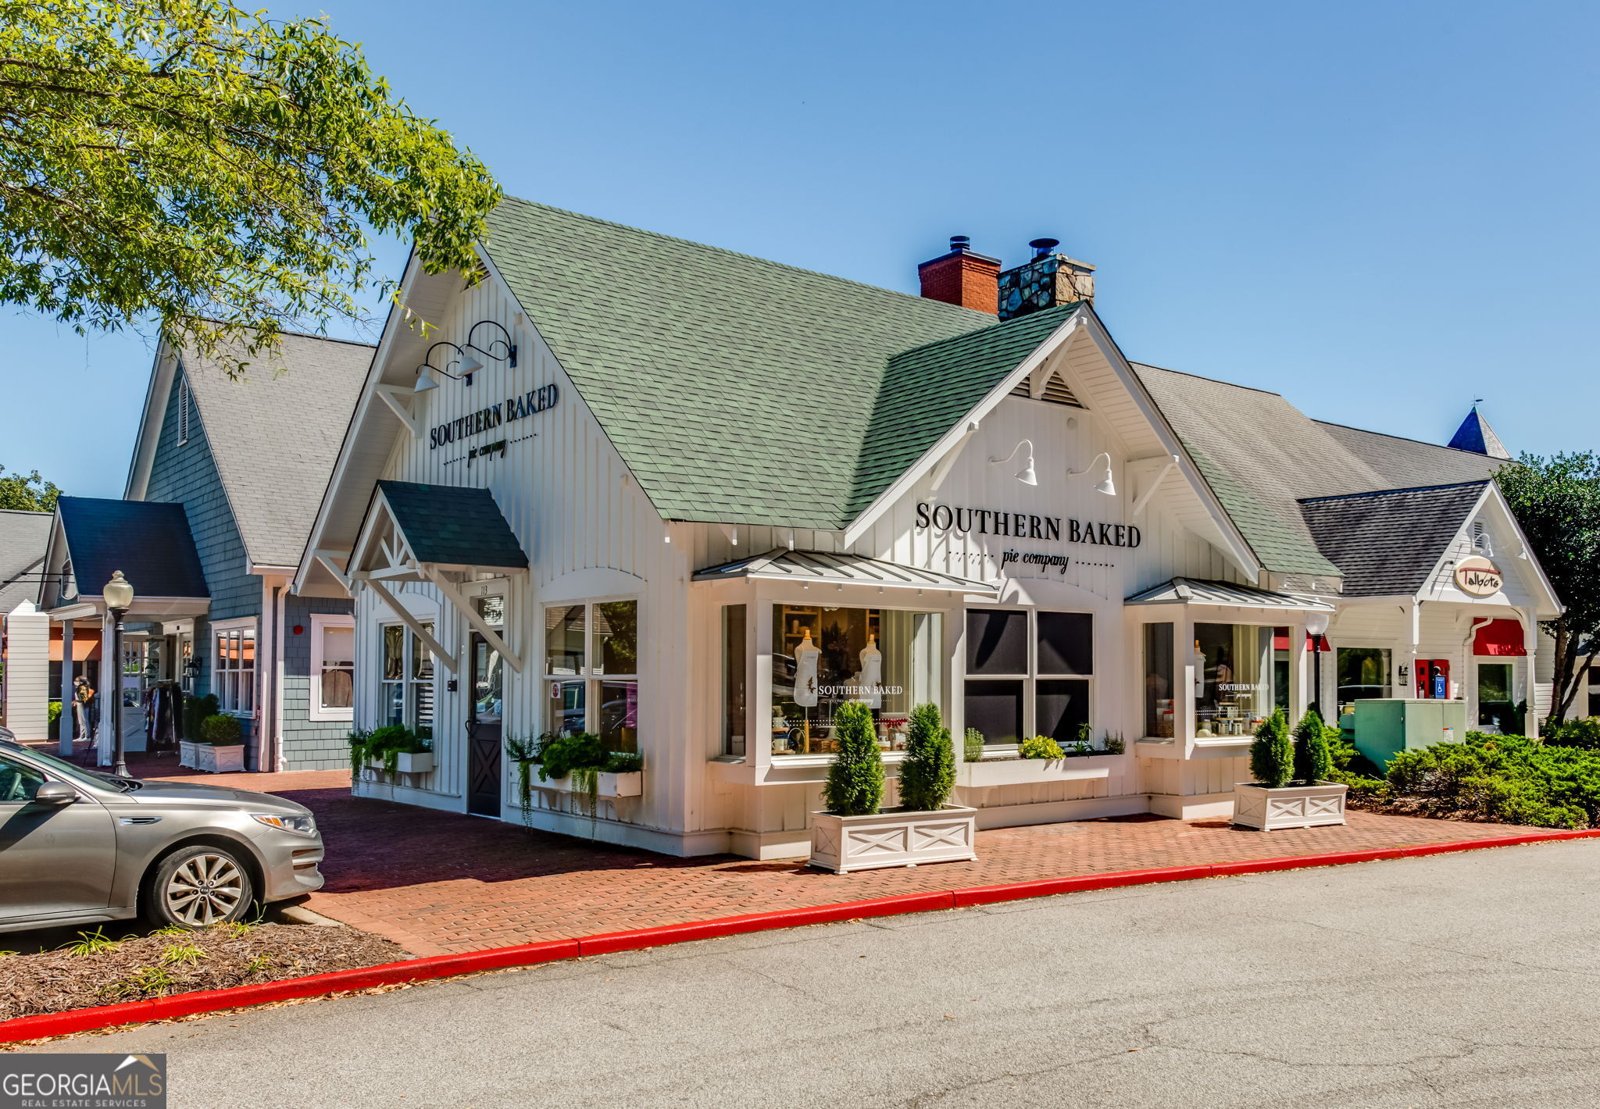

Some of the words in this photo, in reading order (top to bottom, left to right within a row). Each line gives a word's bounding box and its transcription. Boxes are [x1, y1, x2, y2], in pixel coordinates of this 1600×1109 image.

[430, 403, 502, 450] SOUTHERN
[506, 383, 559, 423] BAKED
[916, 503, 1061, 541] SOUTHERN
[1069, 519, 1141, 548] BAKED
[1001, 549, 1019, 569] pie
[1023, 552, 1069, 574] company
[1459, 567, 1501, 588] Talbots
[818, 685, 871, 695] SOUTHERN
[873, 685, 903, 695] BAKED
[1218, 683, 1250, 691] SOUTHERN
